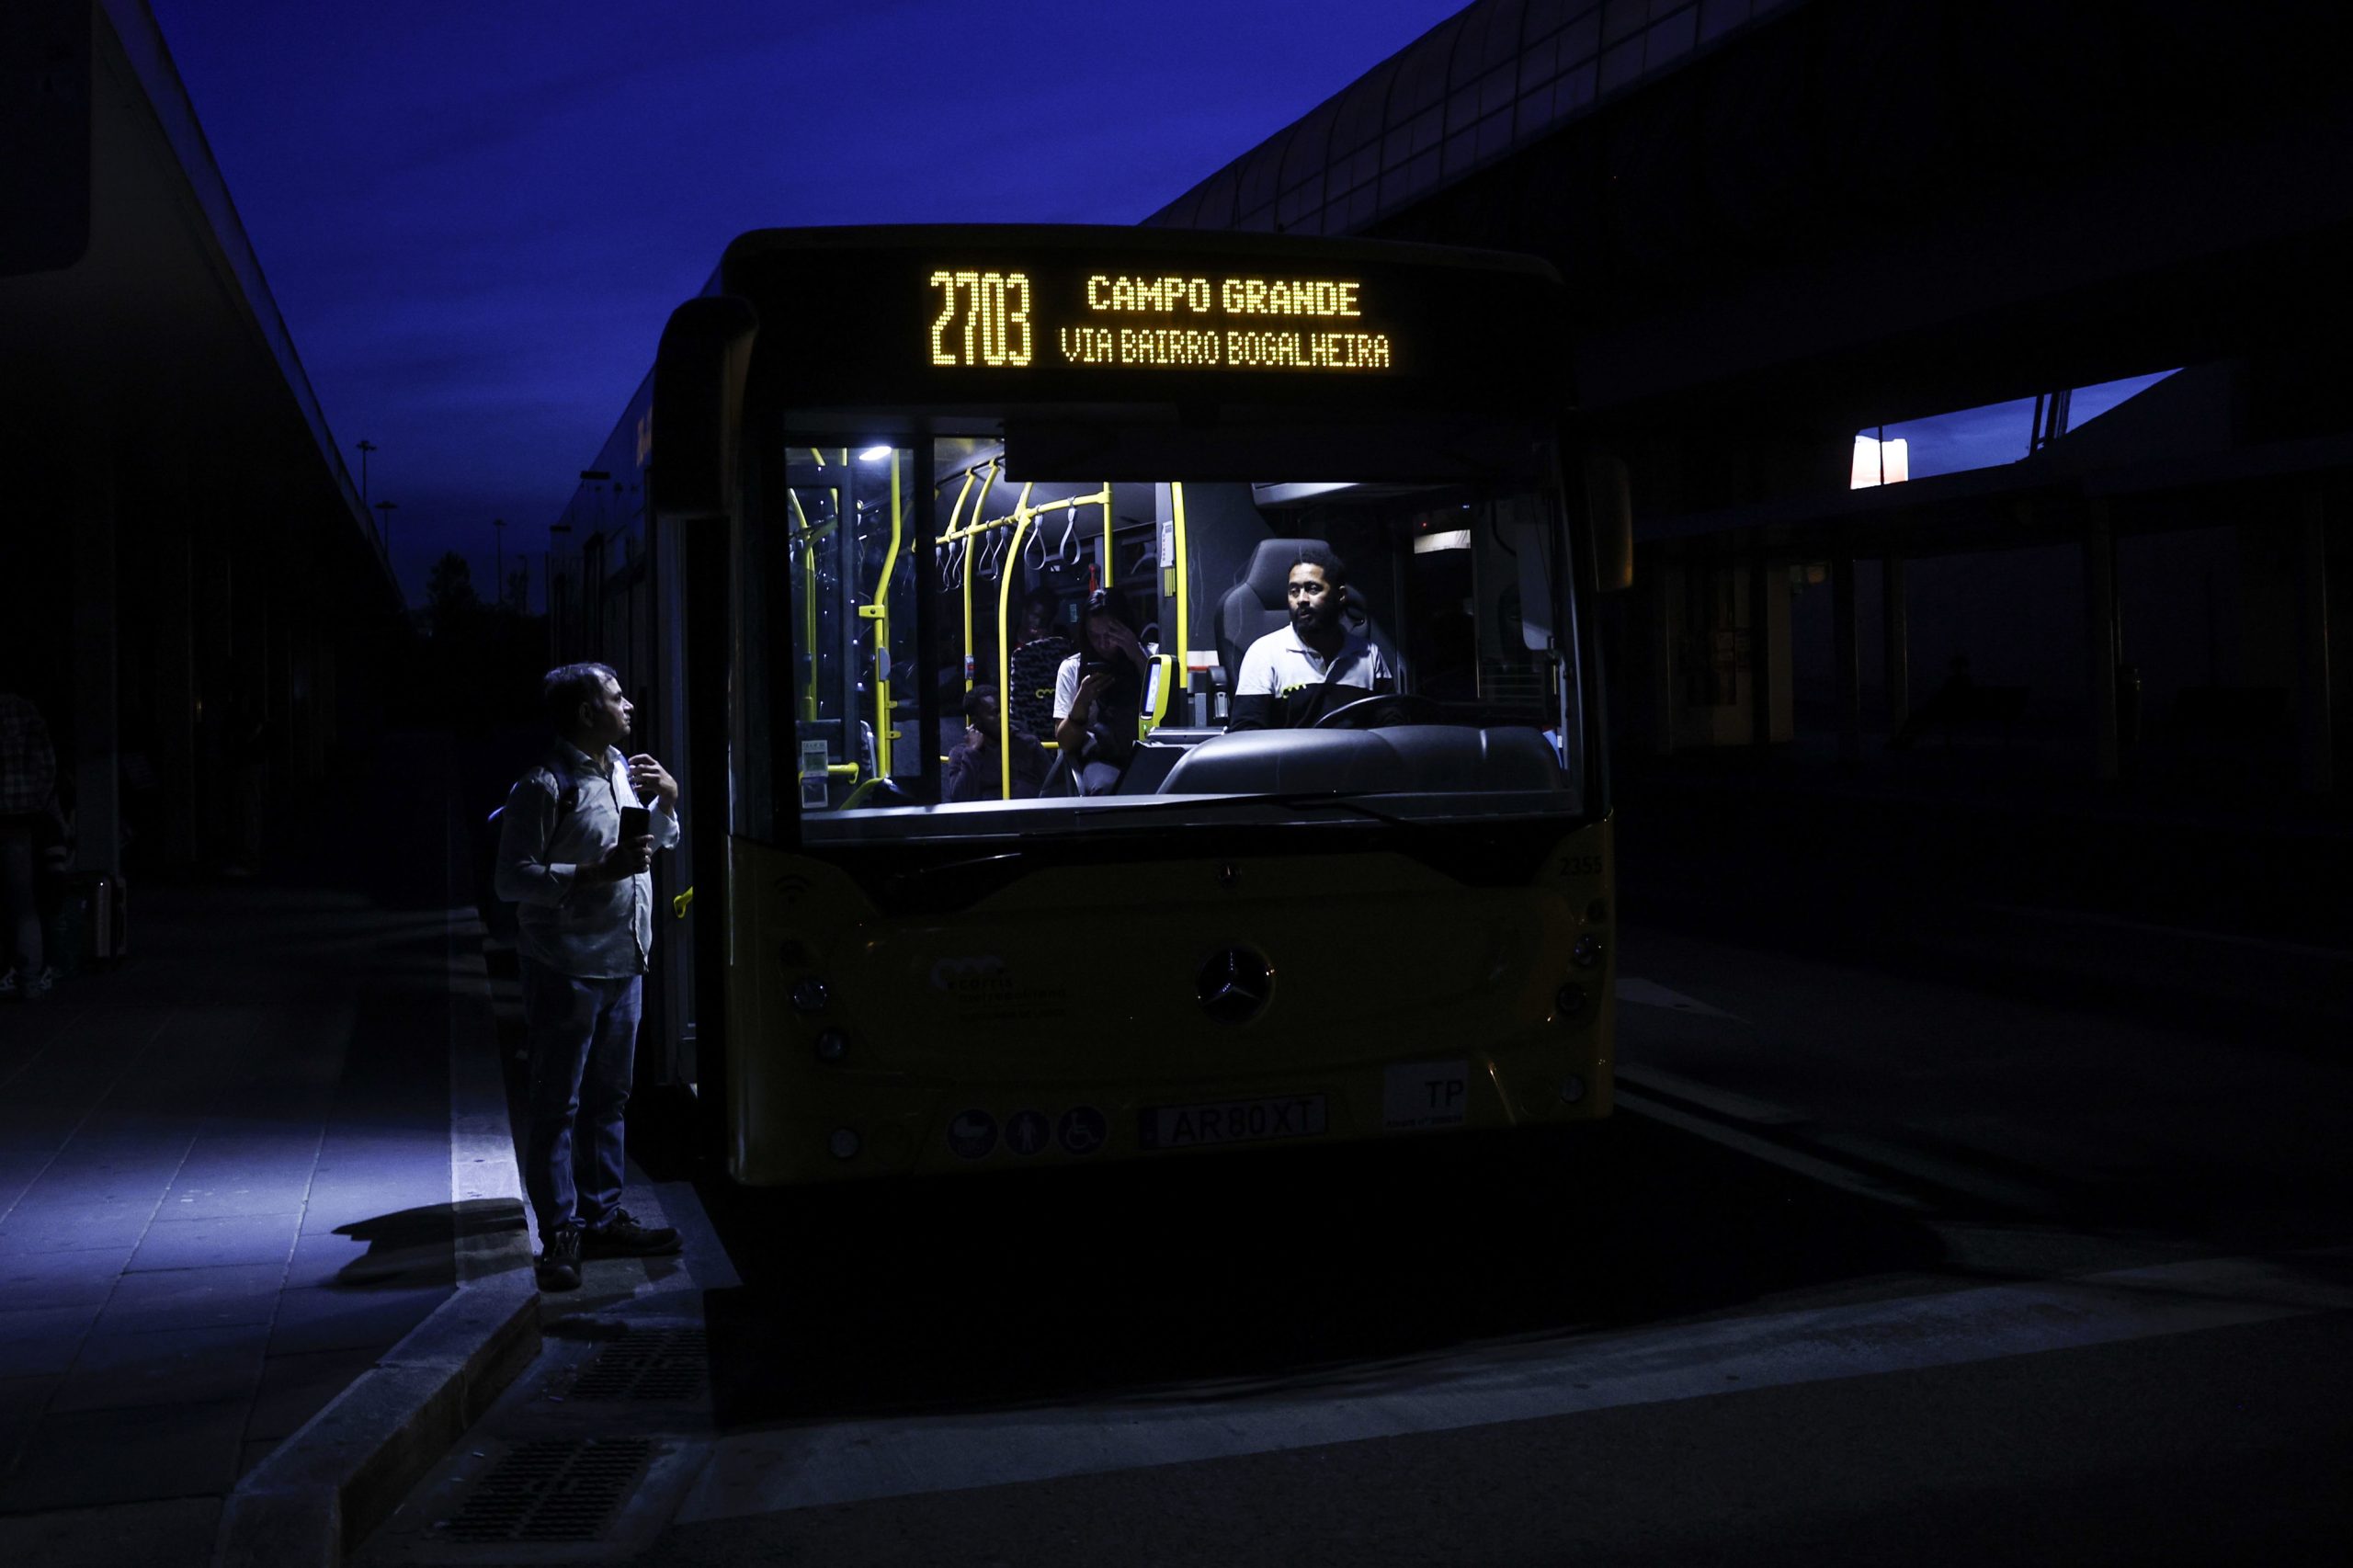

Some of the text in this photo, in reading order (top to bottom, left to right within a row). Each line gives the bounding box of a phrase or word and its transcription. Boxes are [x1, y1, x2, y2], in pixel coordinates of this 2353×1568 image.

[1087, 275, 1361, 316] CAMPO GRANDE
[930, 271, 1031, 366] 2703
[1061, 327, 1390, 368] VIA BAIRRO BOGALHEIRA
[1559, 855, 1602, 876] 2355
[1425, 1079, 1464, 1109] TP
